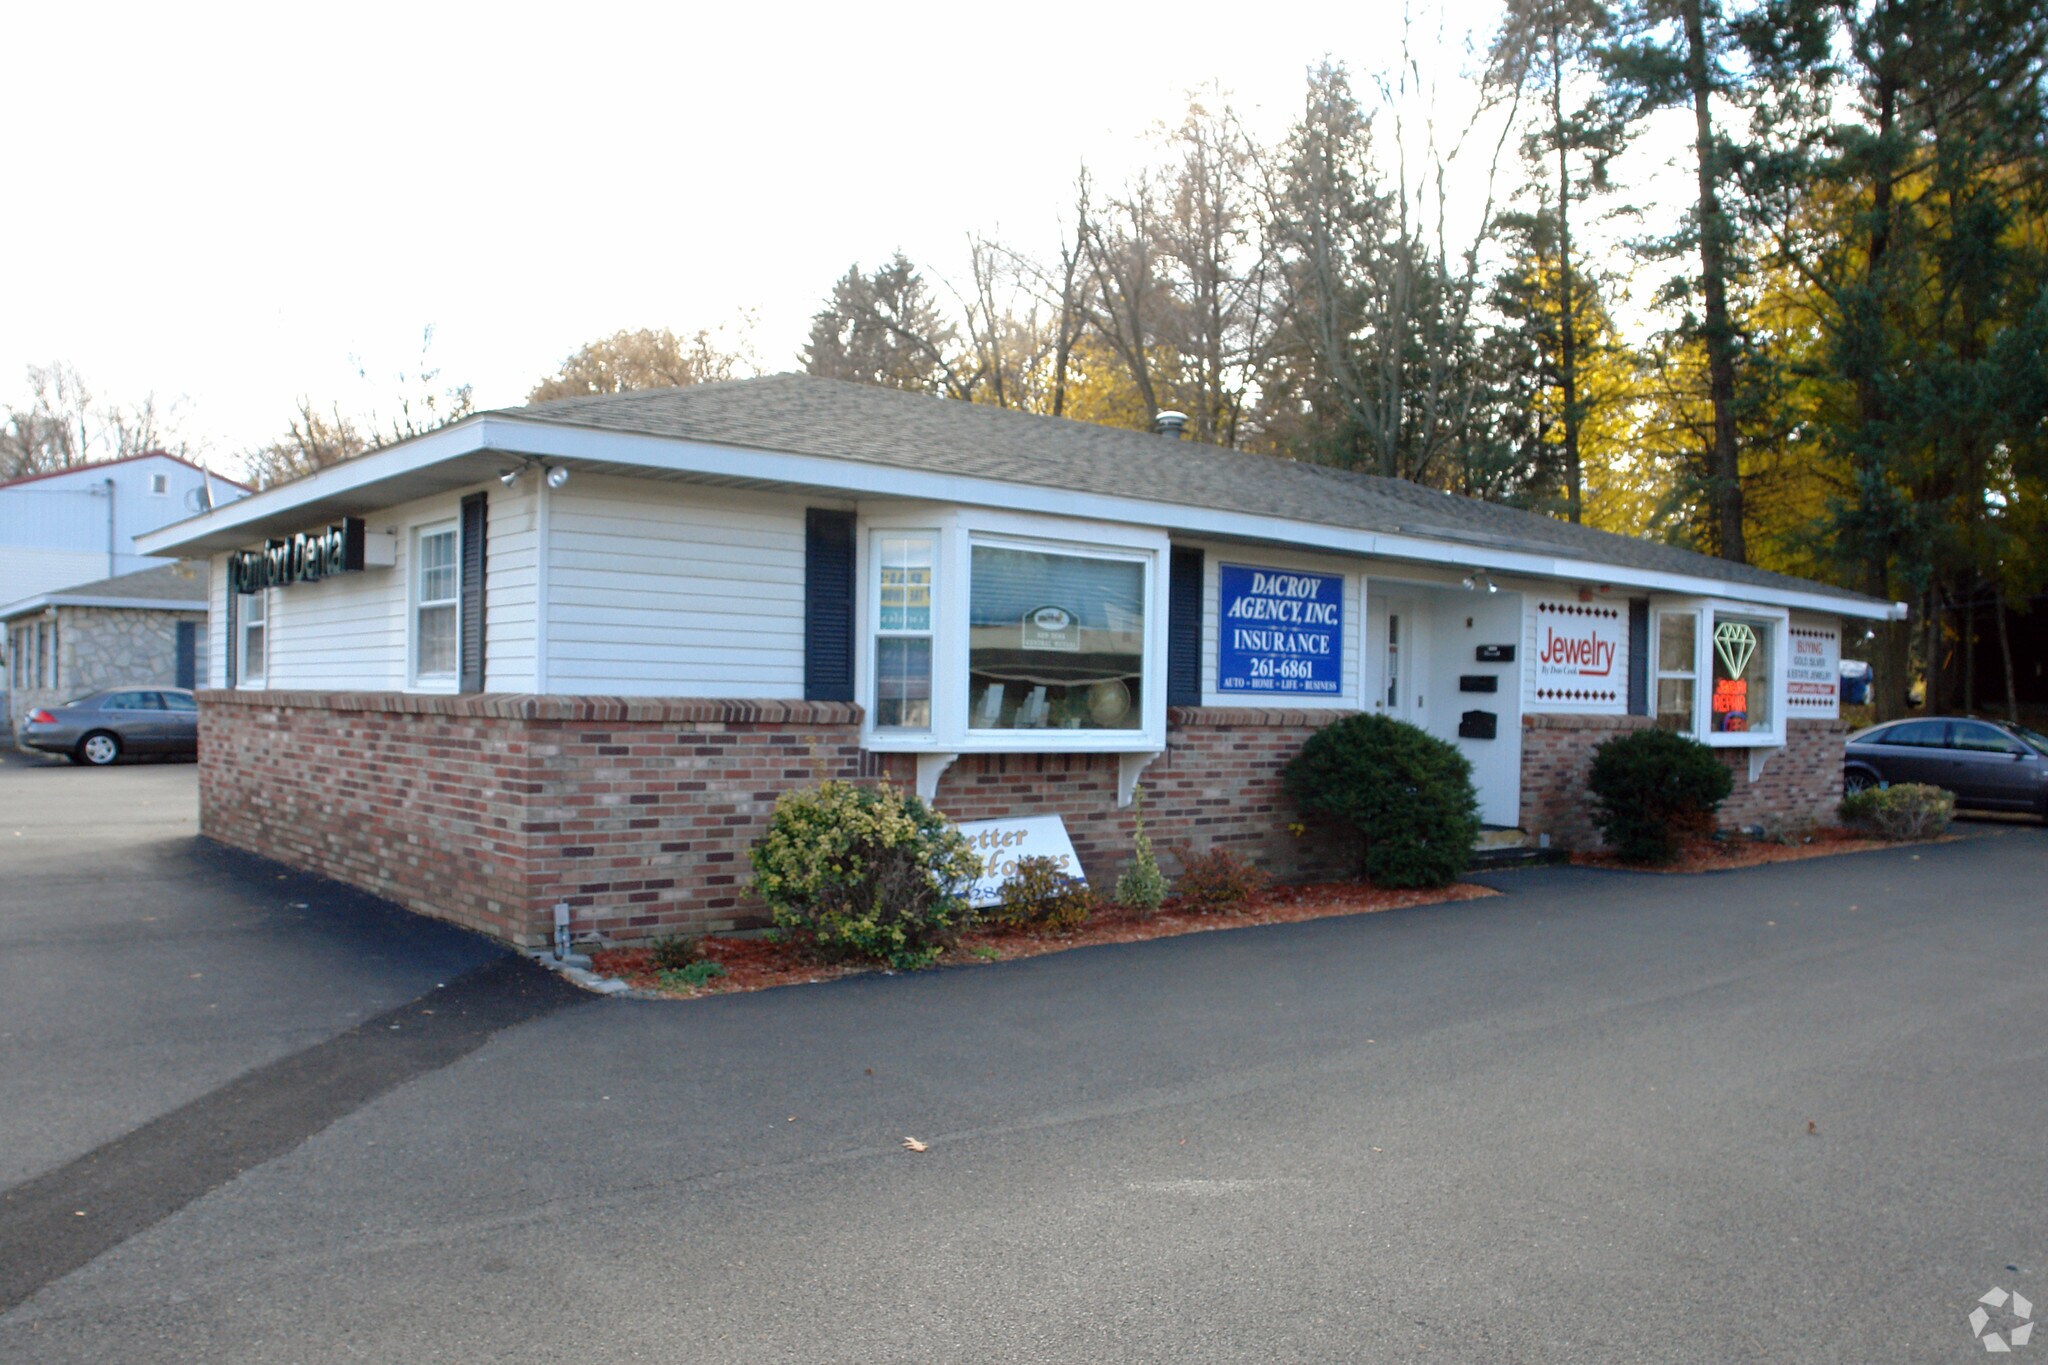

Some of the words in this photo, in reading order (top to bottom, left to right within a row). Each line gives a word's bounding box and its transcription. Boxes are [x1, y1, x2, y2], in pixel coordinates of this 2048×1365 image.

[1251, 572, 1321, 599] DACROY
[1227, 596, 1303, 624] AGENCY,
[1303, 602, 1338, 625] INC.
[1234, 629, 1330, 654] INSURANCE
[1541, 627, 1616, 676] Jewelry
[1796, 640, 1824, 656] BUYING
[1250, 657, 1313, 679] 261-6861
[1224, 676, 1245, 688] AUTO
[1251, 678, 1275, 689] HOME
[1281, 679, 1298, 690] LIFE
[1305, 681, 1337, 692] BUSINESS
[963, 828, 1028, 852] etter
